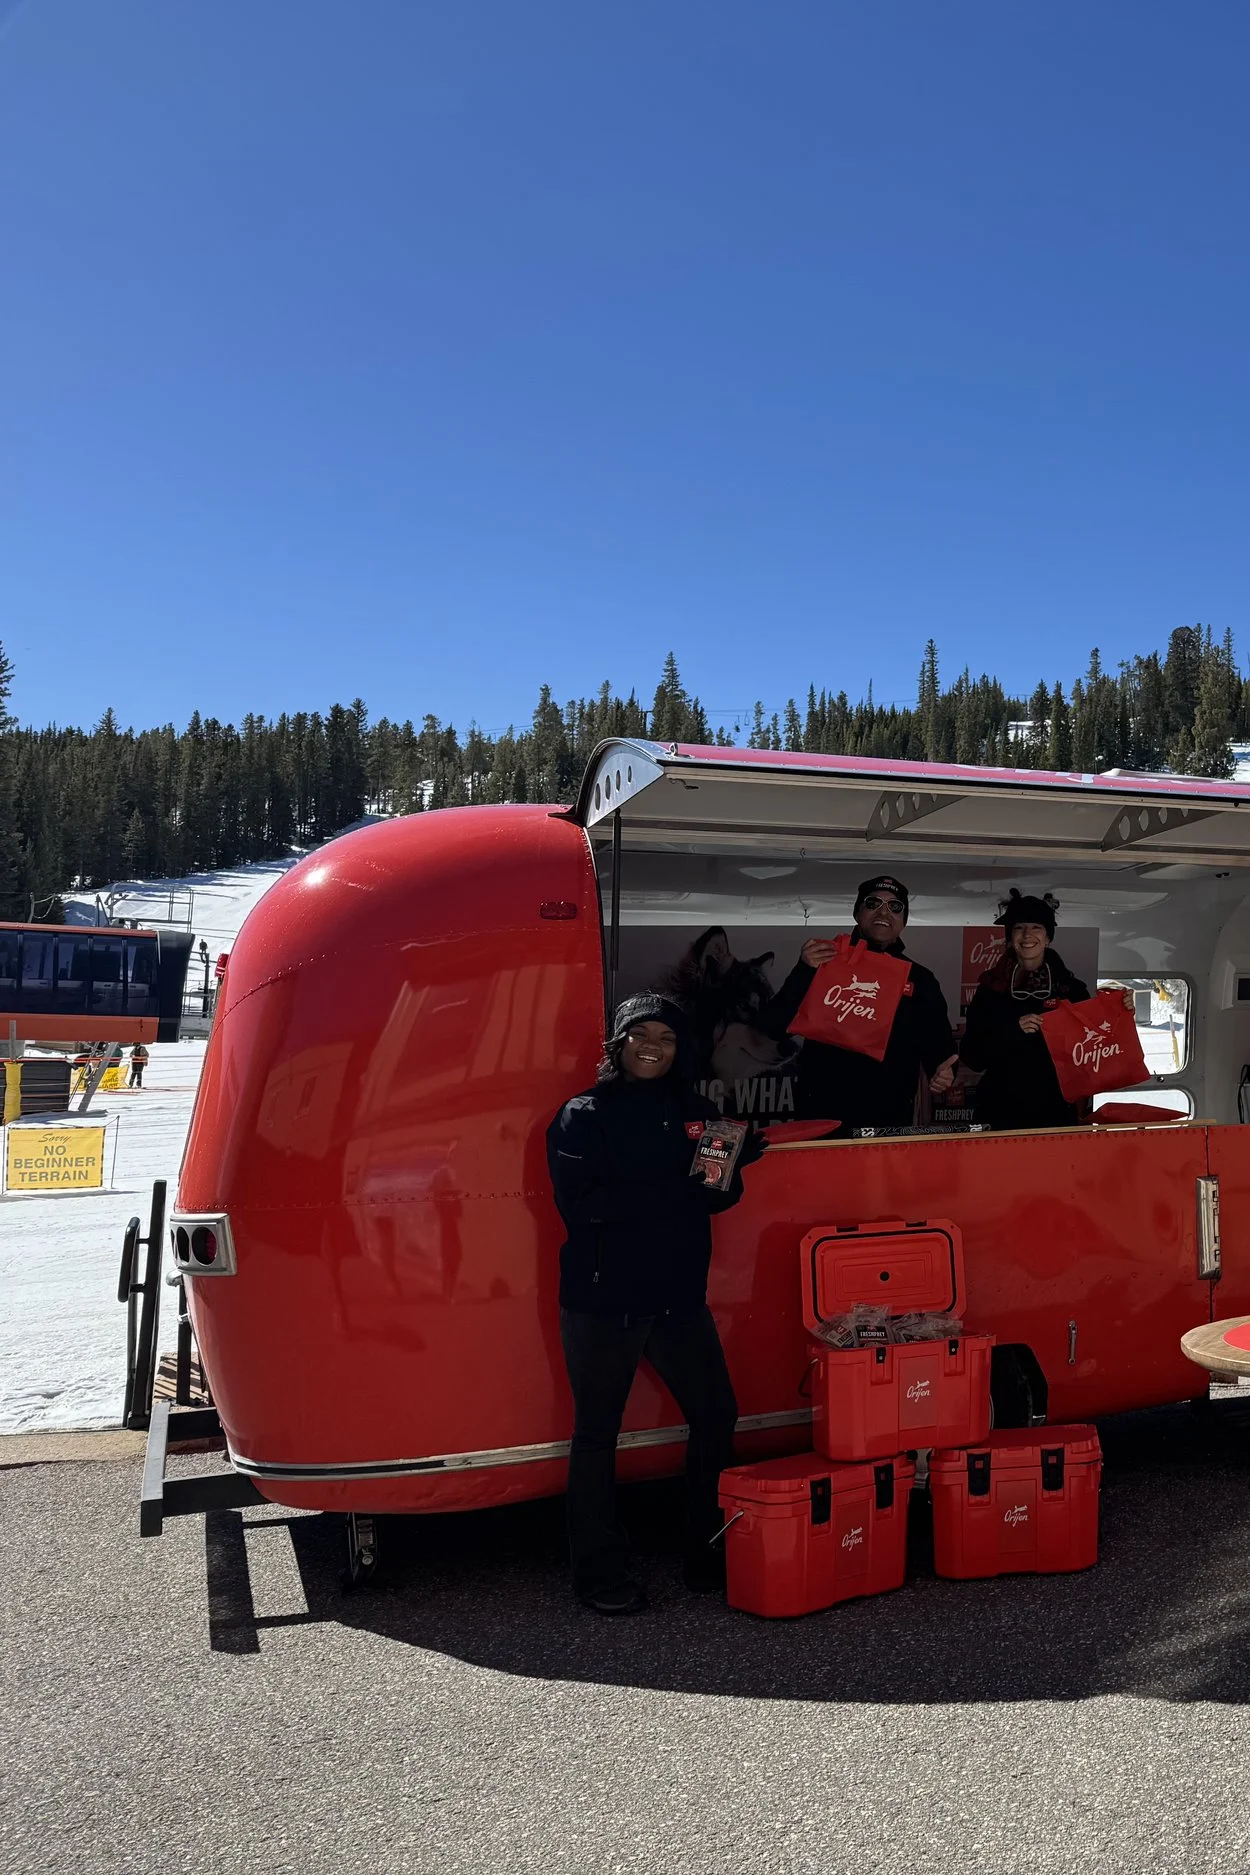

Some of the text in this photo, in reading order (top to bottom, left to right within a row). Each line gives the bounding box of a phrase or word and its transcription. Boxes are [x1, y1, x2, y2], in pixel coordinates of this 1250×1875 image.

[970, 942, 1003, 972] Orij
[823, 985, 876, 1023] Orijen
[1072, 1042, 1121, 1073] Orijen
[734, 1076, 798, 1114] WHA
[935, 1108, 975, 1121] FRESHPREY
[43, 1145, 67, 1156] NO
[700, 1146, 729, 1159] FRESHPREY
[13, 1156, 96, 1169] BEGINNER
[18, 1170, 89, 1182] TERRAIN
[906, 1385, 931, 1403] Orijen
[1003, 1509, 1028, 1528] Orijen
[841, 1534, 863, 1552] Orijen
